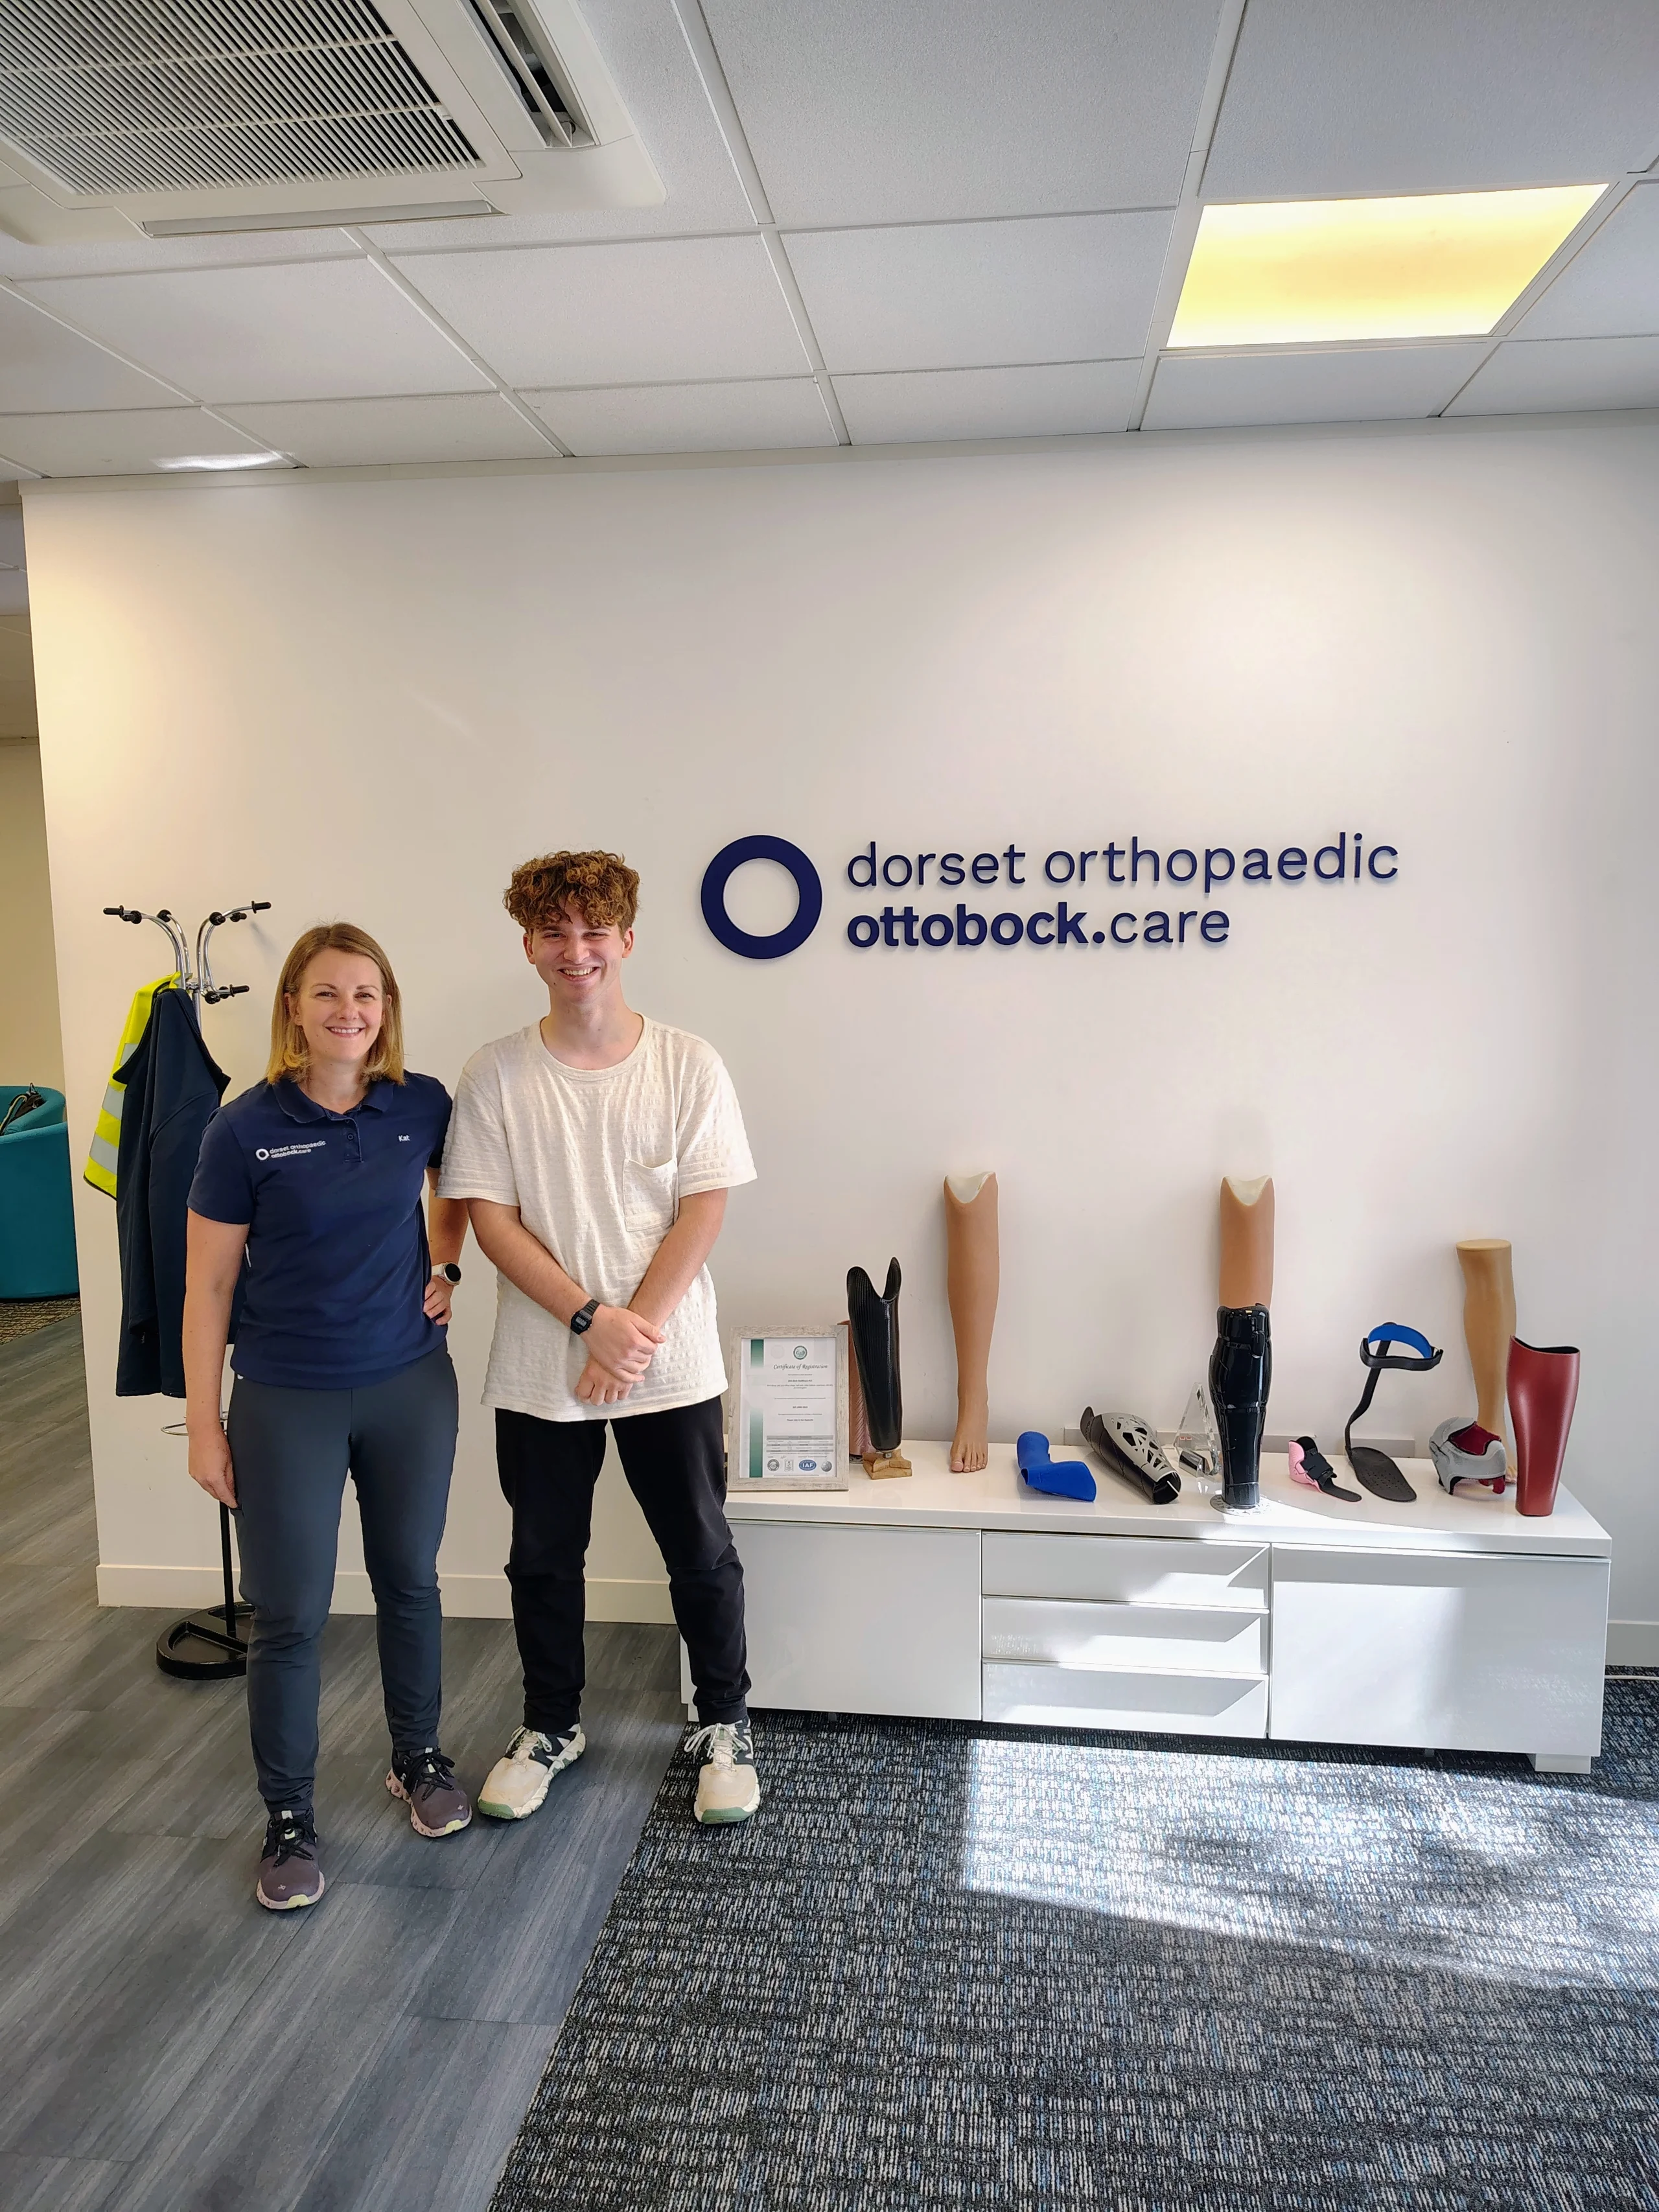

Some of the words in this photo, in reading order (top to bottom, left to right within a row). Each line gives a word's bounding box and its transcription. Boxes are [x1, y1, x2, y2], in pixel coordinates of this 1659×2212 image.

[846, 841, 1027, 888] dorset
[1044, 832, 1399, 894] orthopaedic
[846, 902, 1231, 949] ottobock.care
[270, 1146, 290, 1154] dorset
[290, 1140, 326, 1150] orthopaedic
